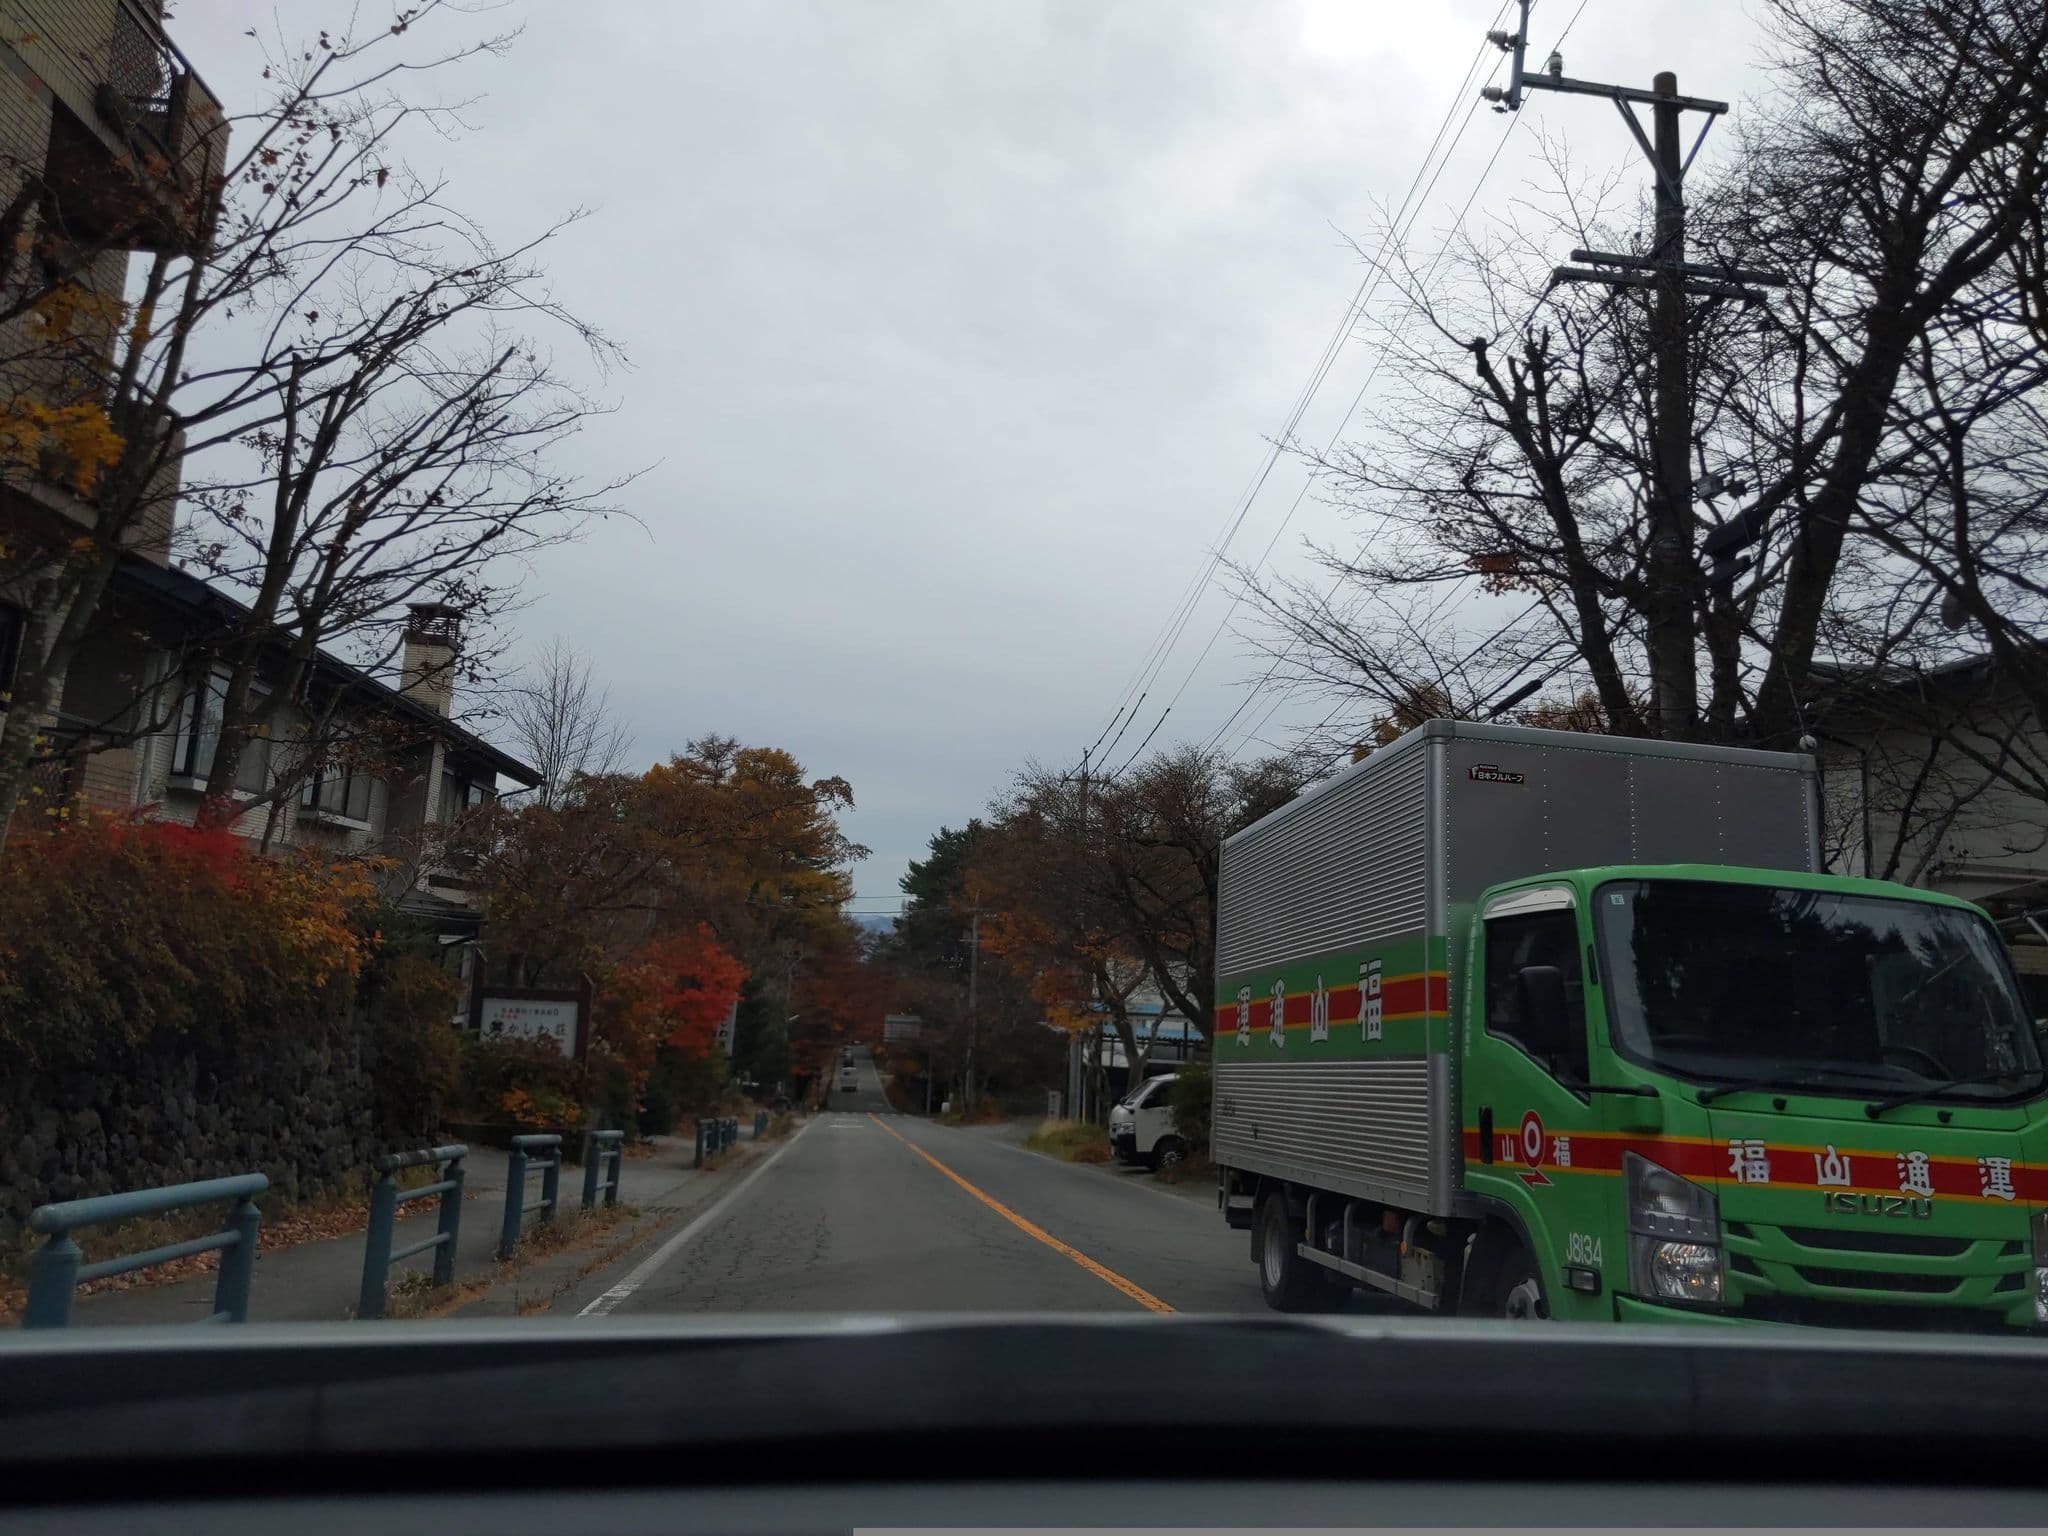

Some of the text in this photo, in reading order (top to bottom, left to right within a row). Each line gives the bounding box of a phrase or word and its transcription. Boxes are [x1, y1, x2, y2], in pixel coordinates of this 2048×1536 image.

[1728, 1138, 2016, 1201] 福山通運
[1823, 1190, 1932, 1220] ISUZU
